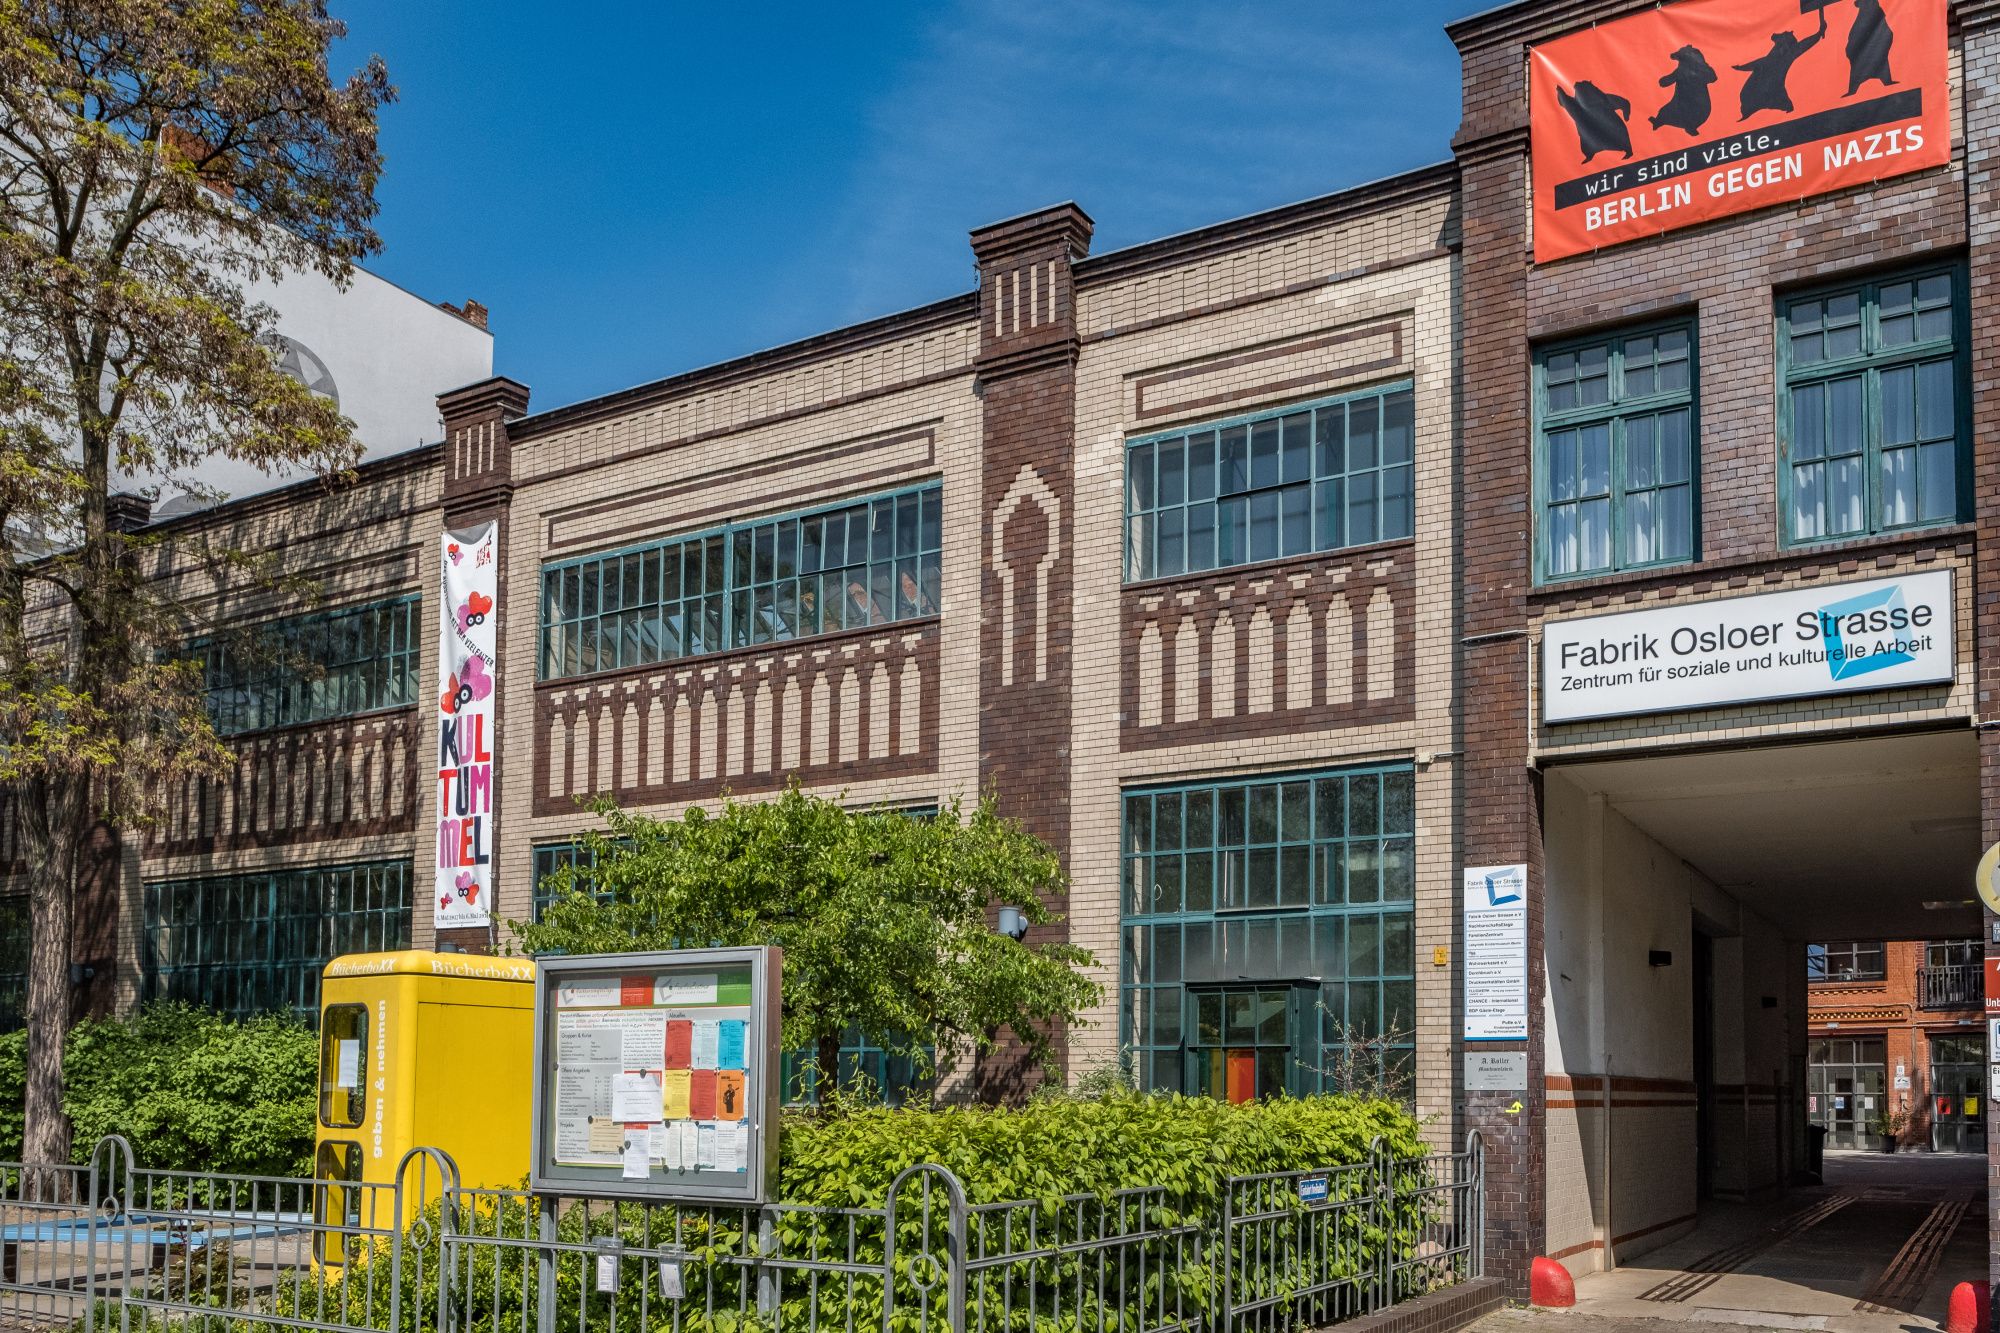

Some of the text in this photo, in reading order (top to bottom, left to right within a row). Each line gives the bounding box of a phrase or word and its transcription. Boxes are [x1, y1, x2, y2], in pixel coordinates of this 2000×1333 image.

[1585, 125, 1924, 232] BERLIN GEGEN NAZIS
[1586, 134, 1780, 197] wir sind viele.
[464, 637, 494, 668] VIELFALTER
[1560, 604, 1932, 669] Fabrik Osloer Strasse
[1560, 635, 1932, 692] Zentrum für soziale und kulturelle Arbeit
[441, 714, 491, 767] KUL
[438, 764, 491, 817] TUM
[440, 816, 489, 868] MEL
[332, 958, 398, 976] BücherboXX
[431, 959, 532, 981] BücherboXX
[373, 1000, 386, 1159] geben & nehmen
